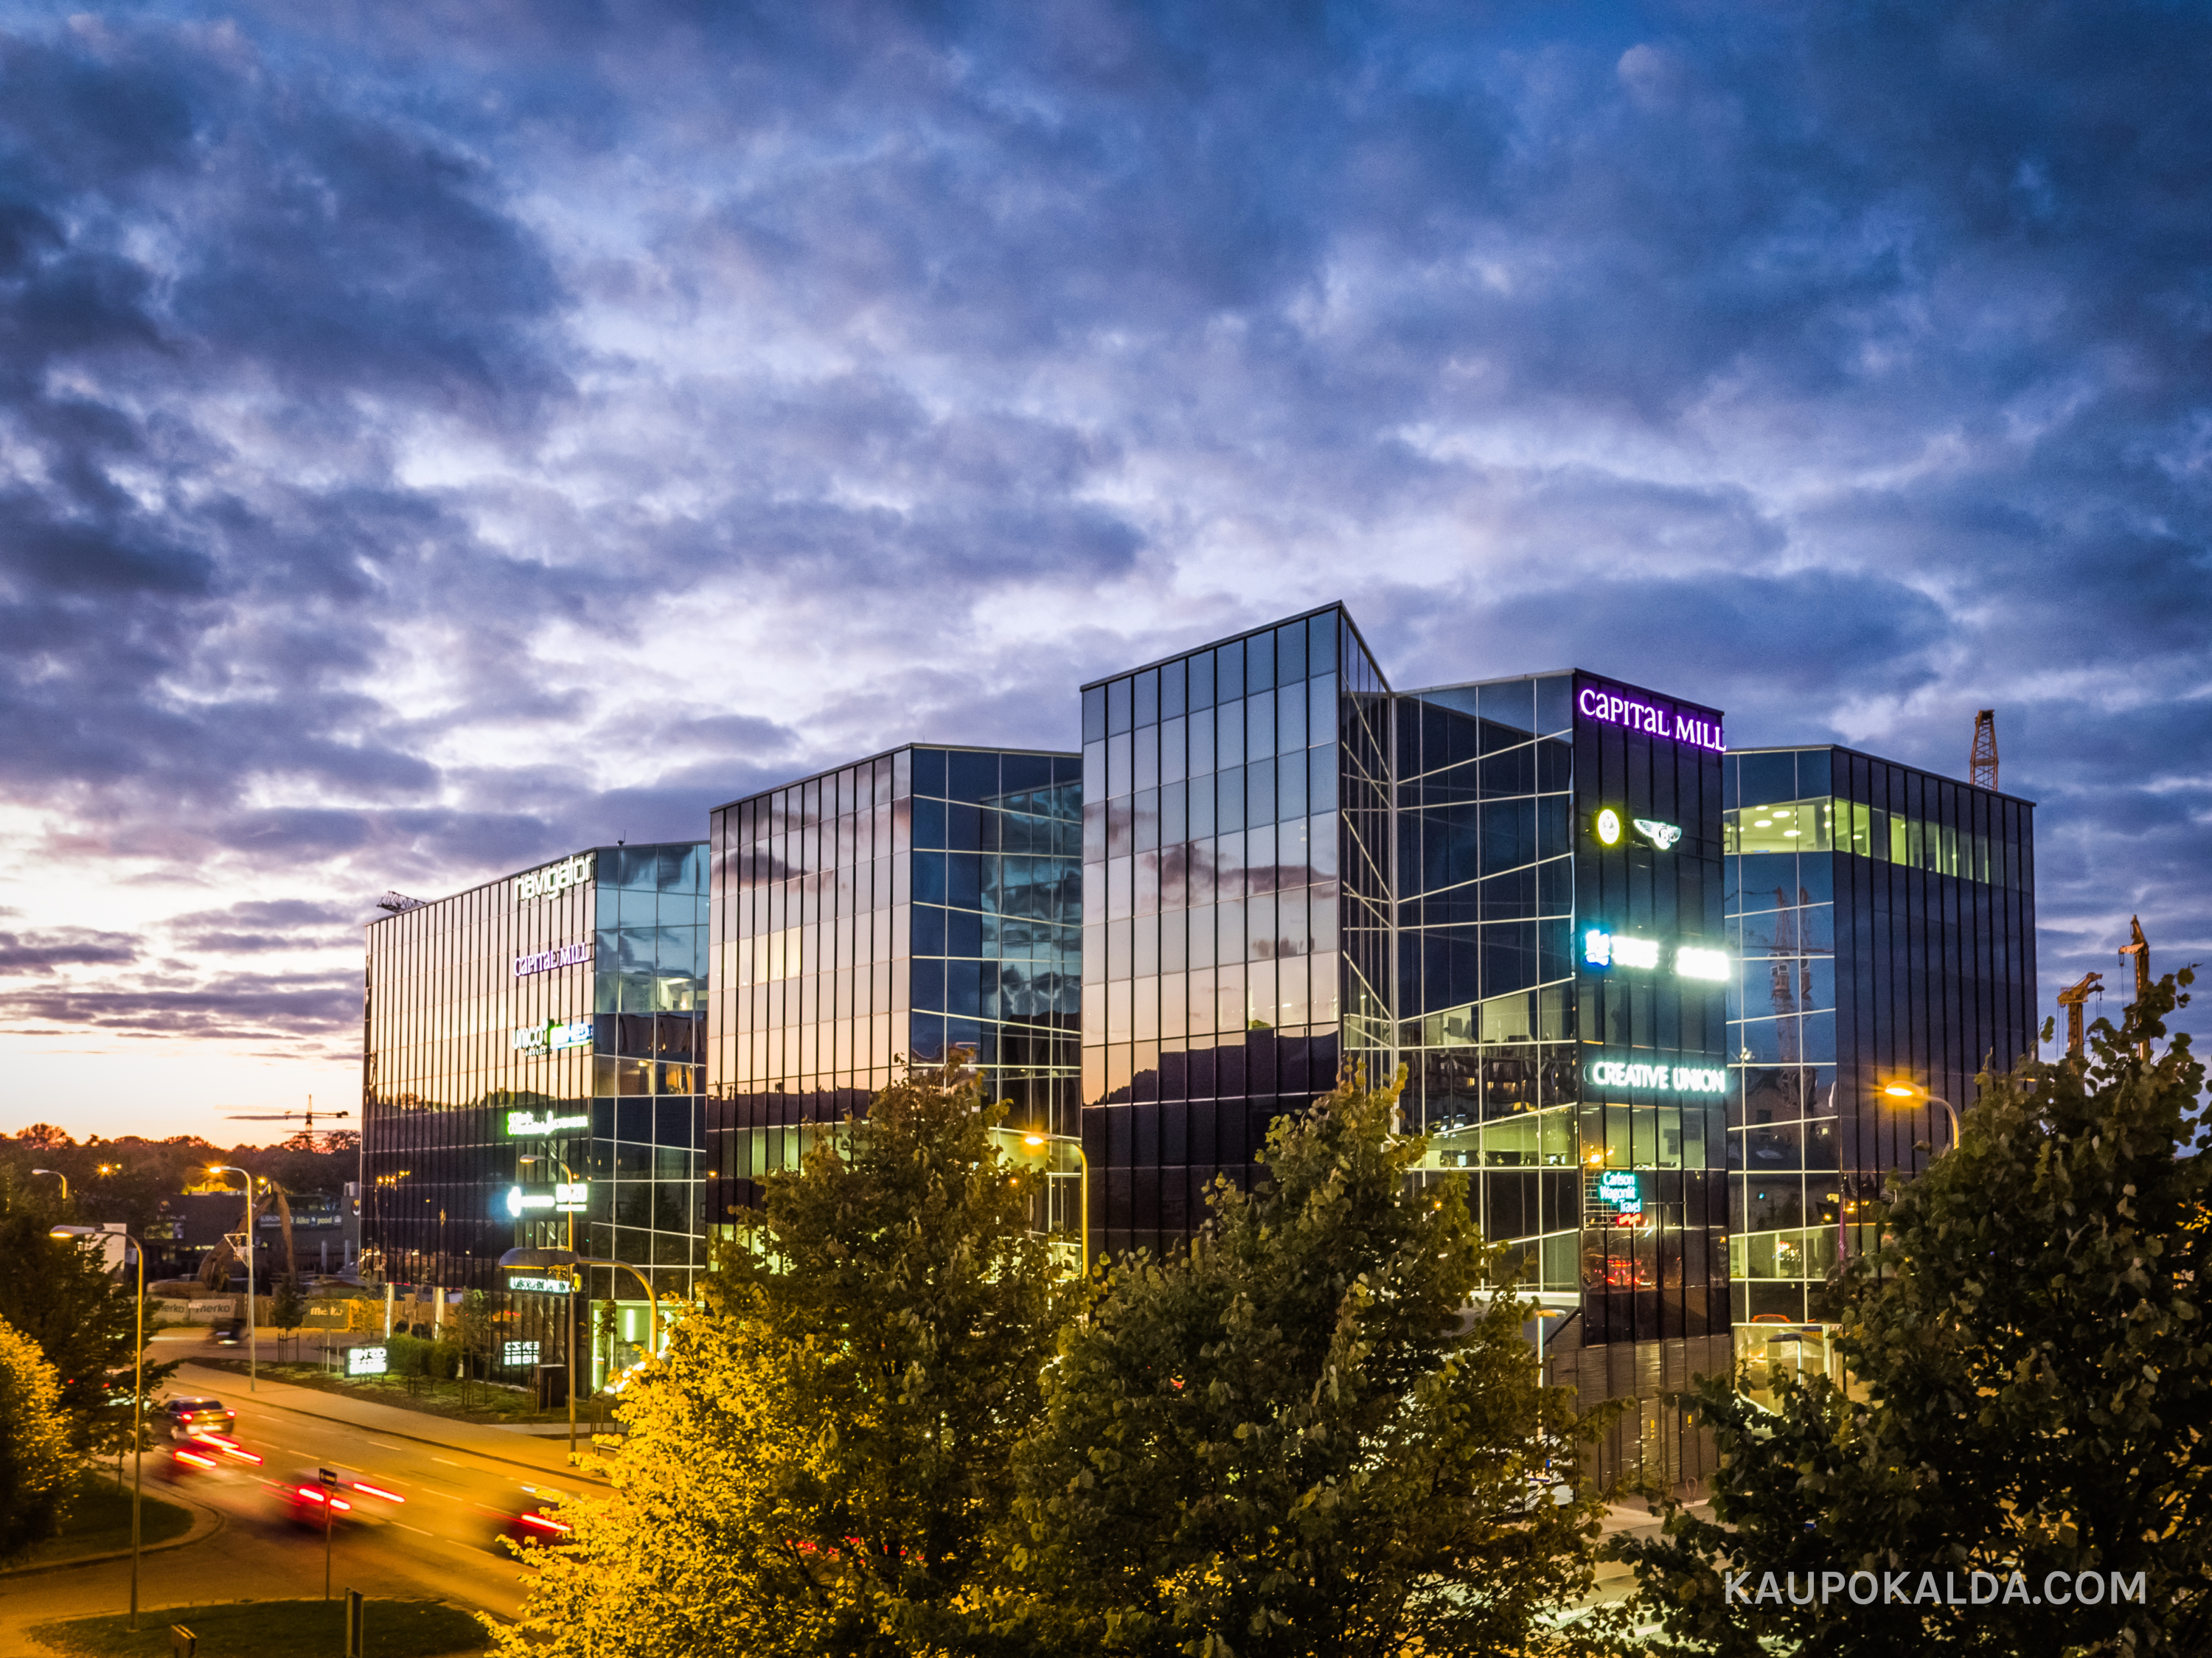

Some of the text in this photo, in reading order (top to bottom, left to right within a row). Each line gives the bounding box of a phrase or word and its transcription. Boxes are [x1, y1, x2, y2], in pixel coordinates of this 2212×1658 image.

[1675, 715, 1727, 752] MILL
[514, 855, 591, 902] navigator
[559, 942, 590, 966] MILL
[1593, 1062, 1725, 1093] CREATIVE UNION
[1604, 1171, 1635, 1185] Carlson
[1599, 1185, 1635, 1203] Wagonlit
[1618, 1199, 1641, 1213] Travel
